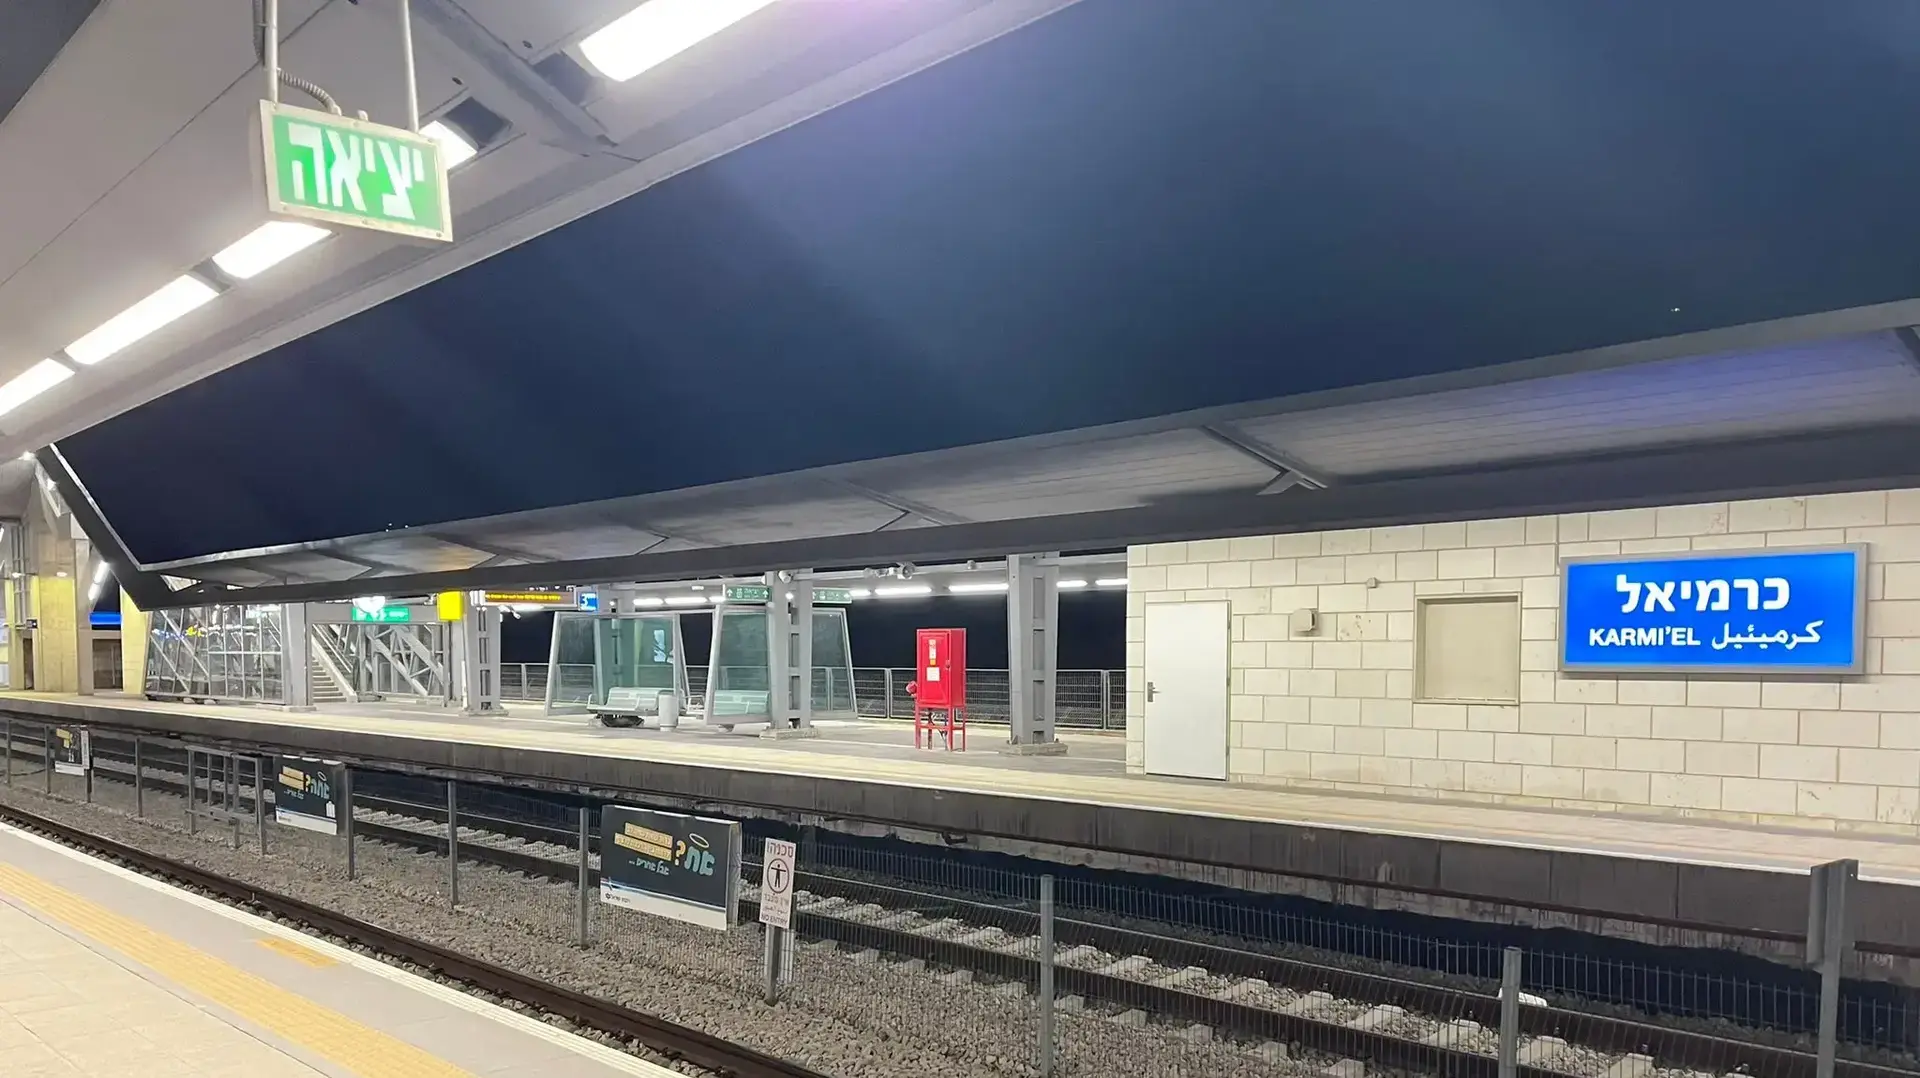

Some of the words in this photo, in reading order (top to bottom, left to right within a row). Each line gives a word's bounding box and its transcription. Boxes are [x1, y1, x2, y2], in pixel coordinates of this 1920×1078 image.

[288, 122, 425, 220] יציאה
[1615, 574, 1791, 613] כרמיאל
[1589, 626, 1701, 647] KARMI'EL
[1711, 620, 1824, 650] كرميئيل
[770, 915, 788, 925] ENTRY
